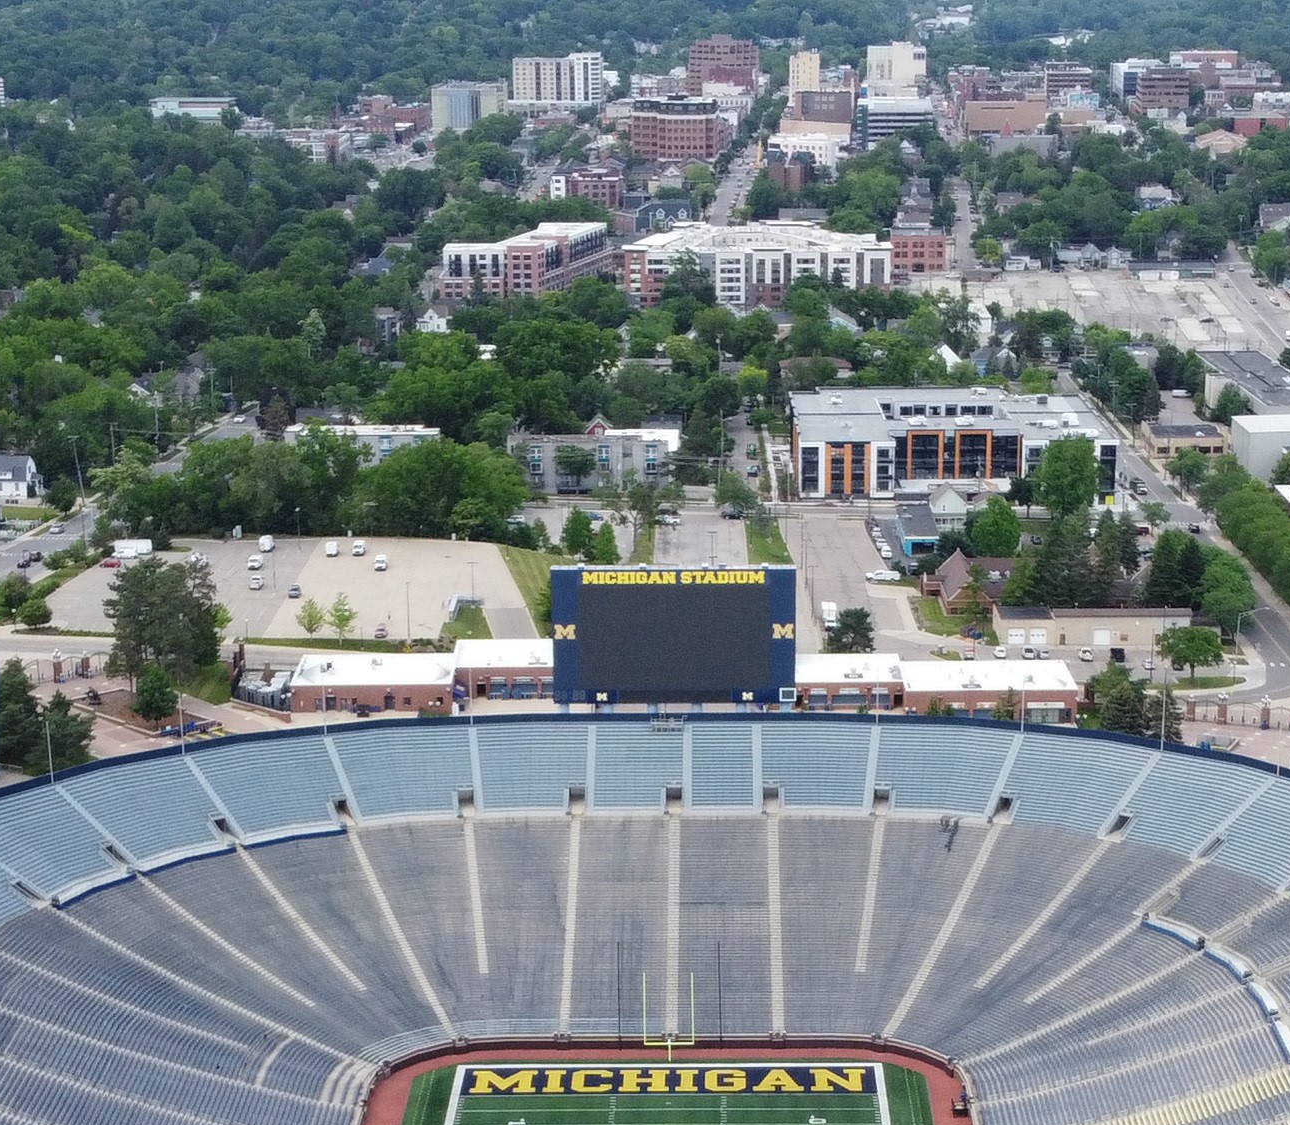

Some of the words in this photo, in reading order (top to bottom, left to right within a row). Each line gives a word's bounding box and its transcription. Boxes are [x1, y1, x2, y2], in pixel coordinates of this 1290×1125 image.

[582, 571, 676, 585] MICHIGAN
[680, 570, 766, 584] STADIUM
[554, 624, 576, 640] M
[772, 623, 794, 639] M
[596, 692, 608, 701] M
[742, 691, 754, 701] M
[468, 1068, 867, 1093] MICHIGAN
